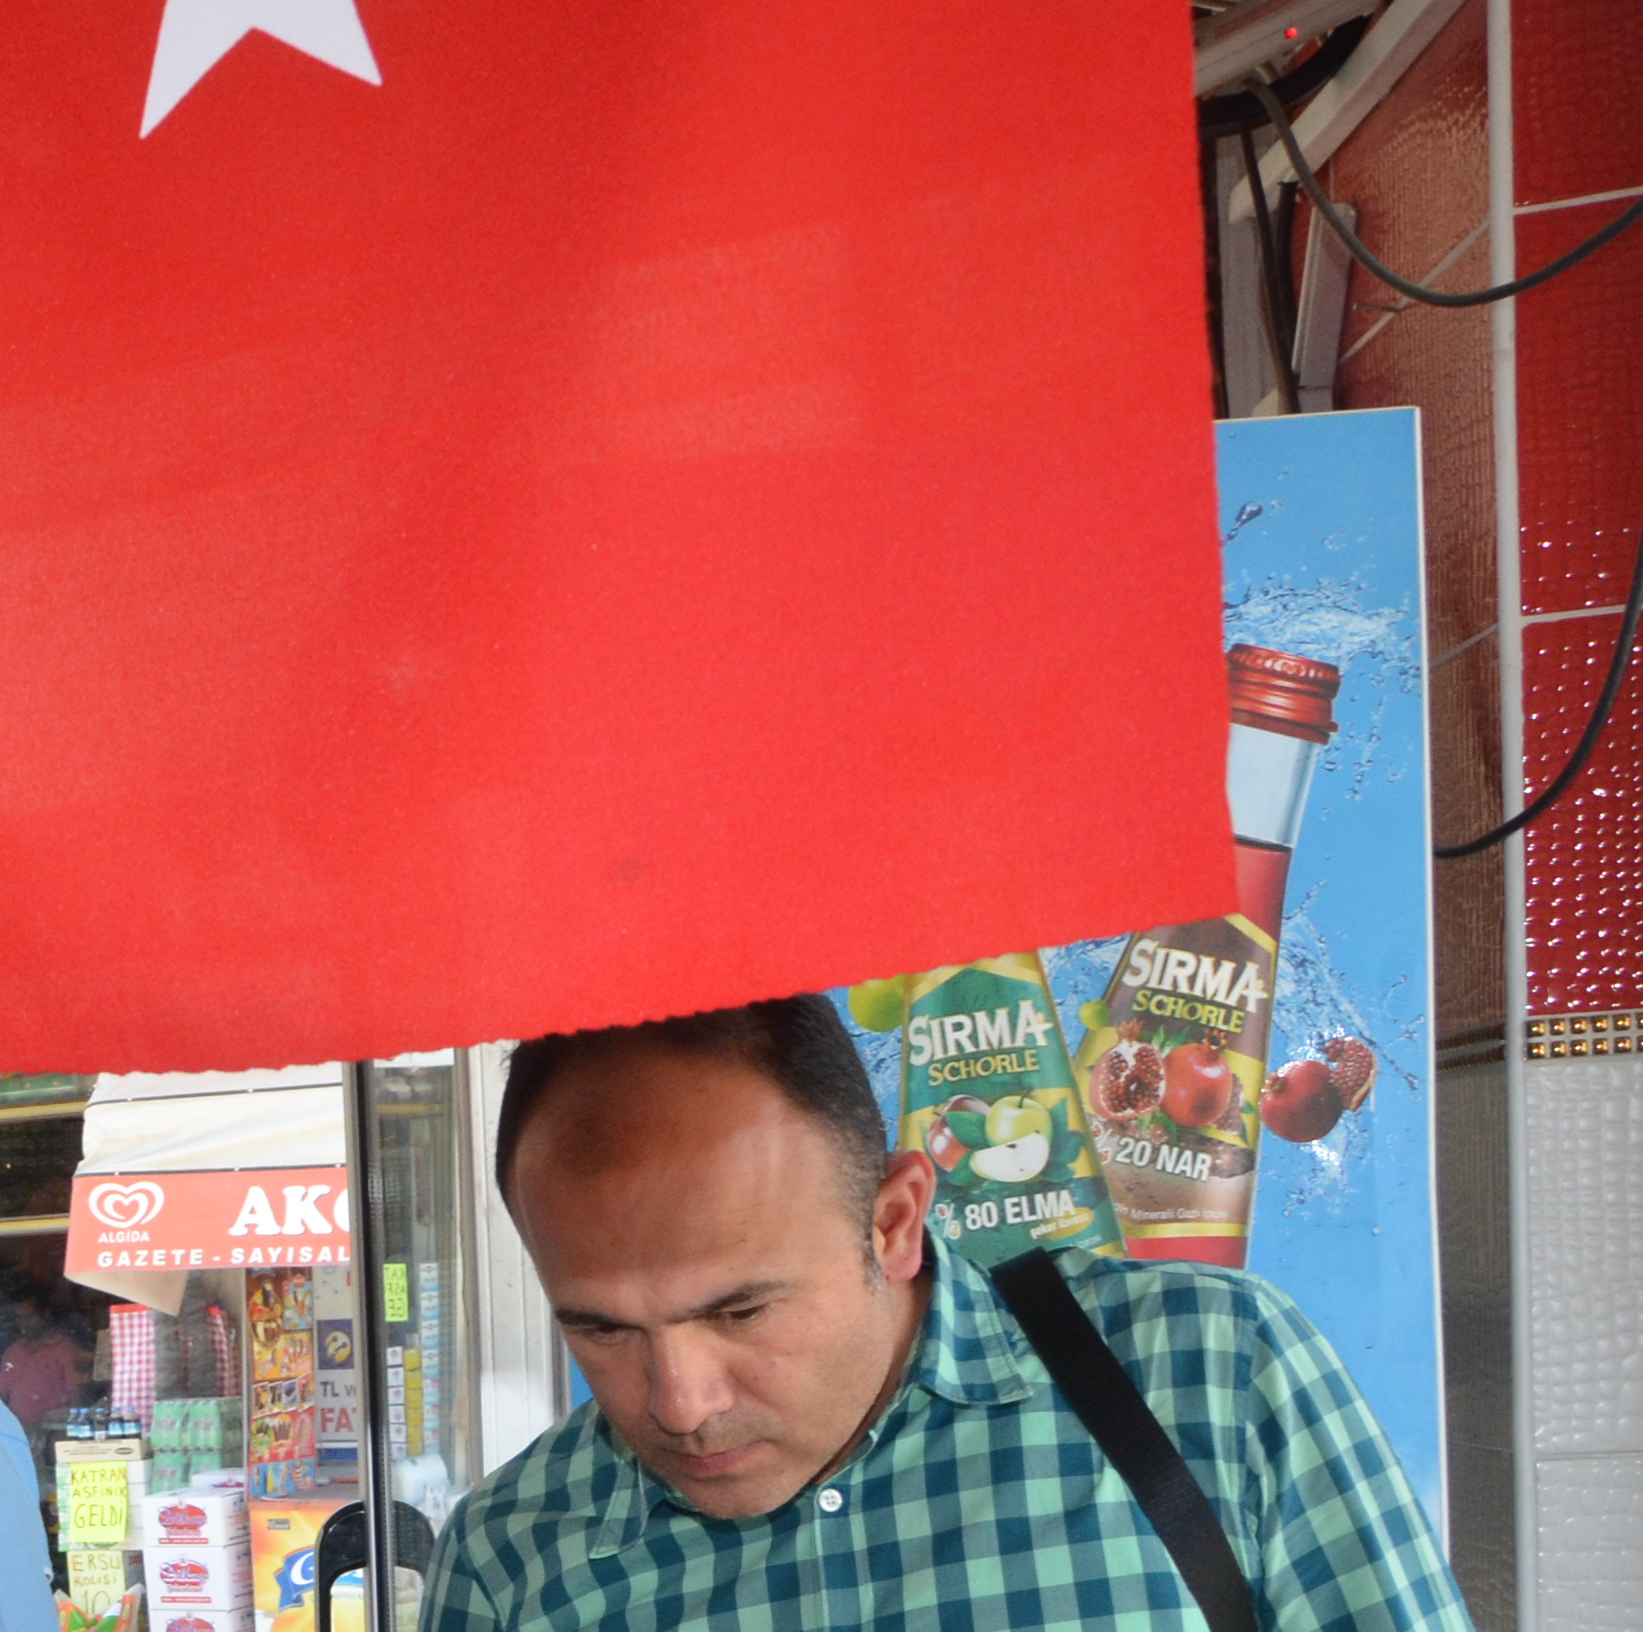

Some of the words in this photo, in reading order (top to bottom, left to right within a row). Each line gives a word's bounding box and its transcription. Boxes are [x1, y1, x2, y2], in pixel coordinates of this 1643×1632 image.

[1121, 937, 1267, 1013] SIRMA
[1131, 988, 1245, 1033] SCHORLE
[908, 999, 1052, 1067] SIRMA
[928, 1049, 1041, 1087] SCHORLE
[1115, 1137, 1151, 1168] 20
[1155, 1144, 1212, 1182] NAR
[965, 1200, 999, 1230] 80
[1004, 1189, 1076, 1225] ELMA
[98, 1229, 150, 1243] ALGİDA
[97, 1249, 204, 1267] GAZETE
[231, 1246, 350, 1264] SAYISAL
[321, 1381, 339, 1398] TL
[70, 1466, 127, 1484] KATRAN
[73, 1503, 125, 1529] GELDİ
